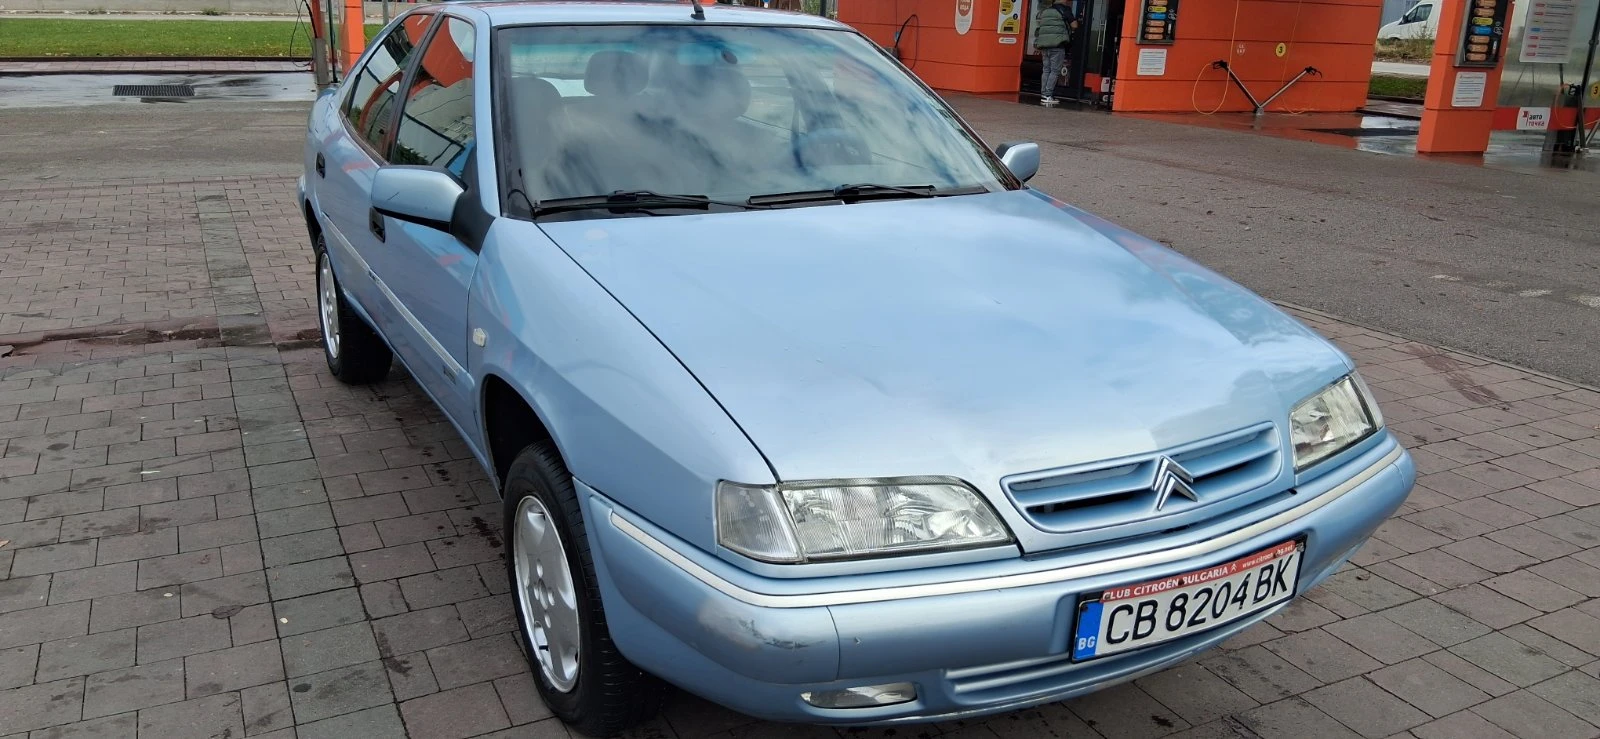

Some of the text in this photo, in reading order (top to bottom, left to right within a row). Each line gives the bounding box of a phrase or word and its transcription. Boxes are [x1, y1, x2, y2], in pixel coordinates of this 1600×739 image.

[1593, 86, 1599, 95] 3
[1242, 544, 1294, 569] www.citroenbg.net
[1102, 566, 1229, 600] CLUB CITROËN BULGARIA
[1106, 554, 1294, 645] CB 8204 BK
[1078, 636, 1096, 650] BG
